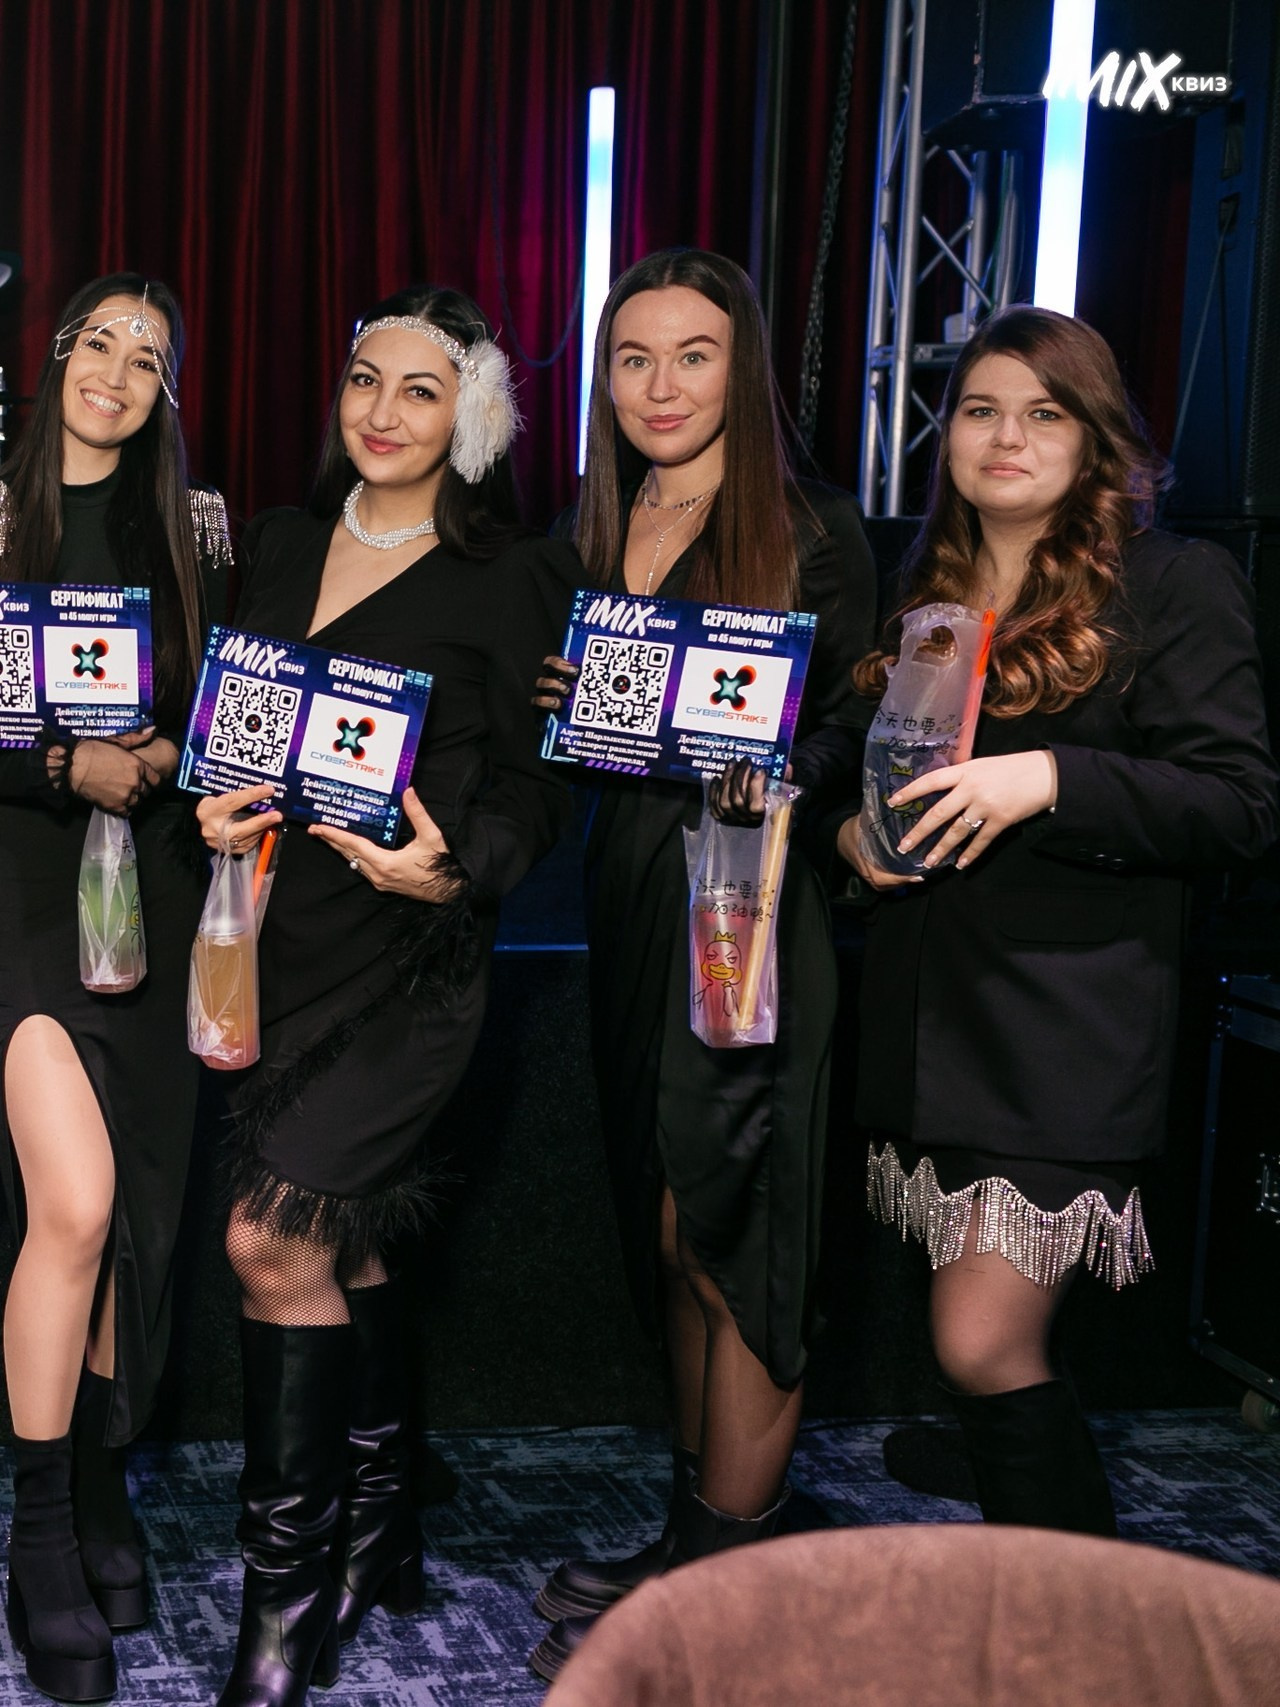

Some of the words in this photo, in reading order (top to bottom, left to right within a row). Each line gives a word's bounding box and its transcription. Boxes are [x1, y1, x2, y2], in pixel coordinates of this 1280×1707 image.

[50, 590, 125, 609] СЕРТИФИКАТ
[68, 611, 77, 621] 45
[100, 614, 117, 623] игры
[584, 596, 656, 636] IMIX
[702, 609, 788, 634] СЕРТИФИКАТ
[718, 633, 729, 643] 45
[753, 639, 773, 649] игры
[220, 635, 287, 679] IMIX
[328, 658, 407, 691] СЕРТИФИКАТ
[55, 681, 127, 691] CYBERSTRIKE
[342, 683, 352, 694] 45
[374, 692, 392, 703] игры
[54, 707, 97, 717] Действует
[686, 706, 768, 724] CYBERSTRIKE
[58, 717, 84, 725] Выдан
[86, 719, 124, 728] 15.12.2024
[560, 728, 584, 737] Адрес
[677, 734, 727, 749] Действует
[728, 741, 735, 749] 3
[736, 744, 770, 755] месяца
[679, 746, 710, 757] Выдан
[195, 760, 217, 770] Адрес
[310, 751, 384, 776] CYBERSTRIKE
[301, 777, 346, 795] Действует
[347, 789, 353, 797] 3
[354, 793, 384, 806] месяца
[303, 788, 330, 802] Выдан
[332, 796, 371, 813] 15.12.2024
